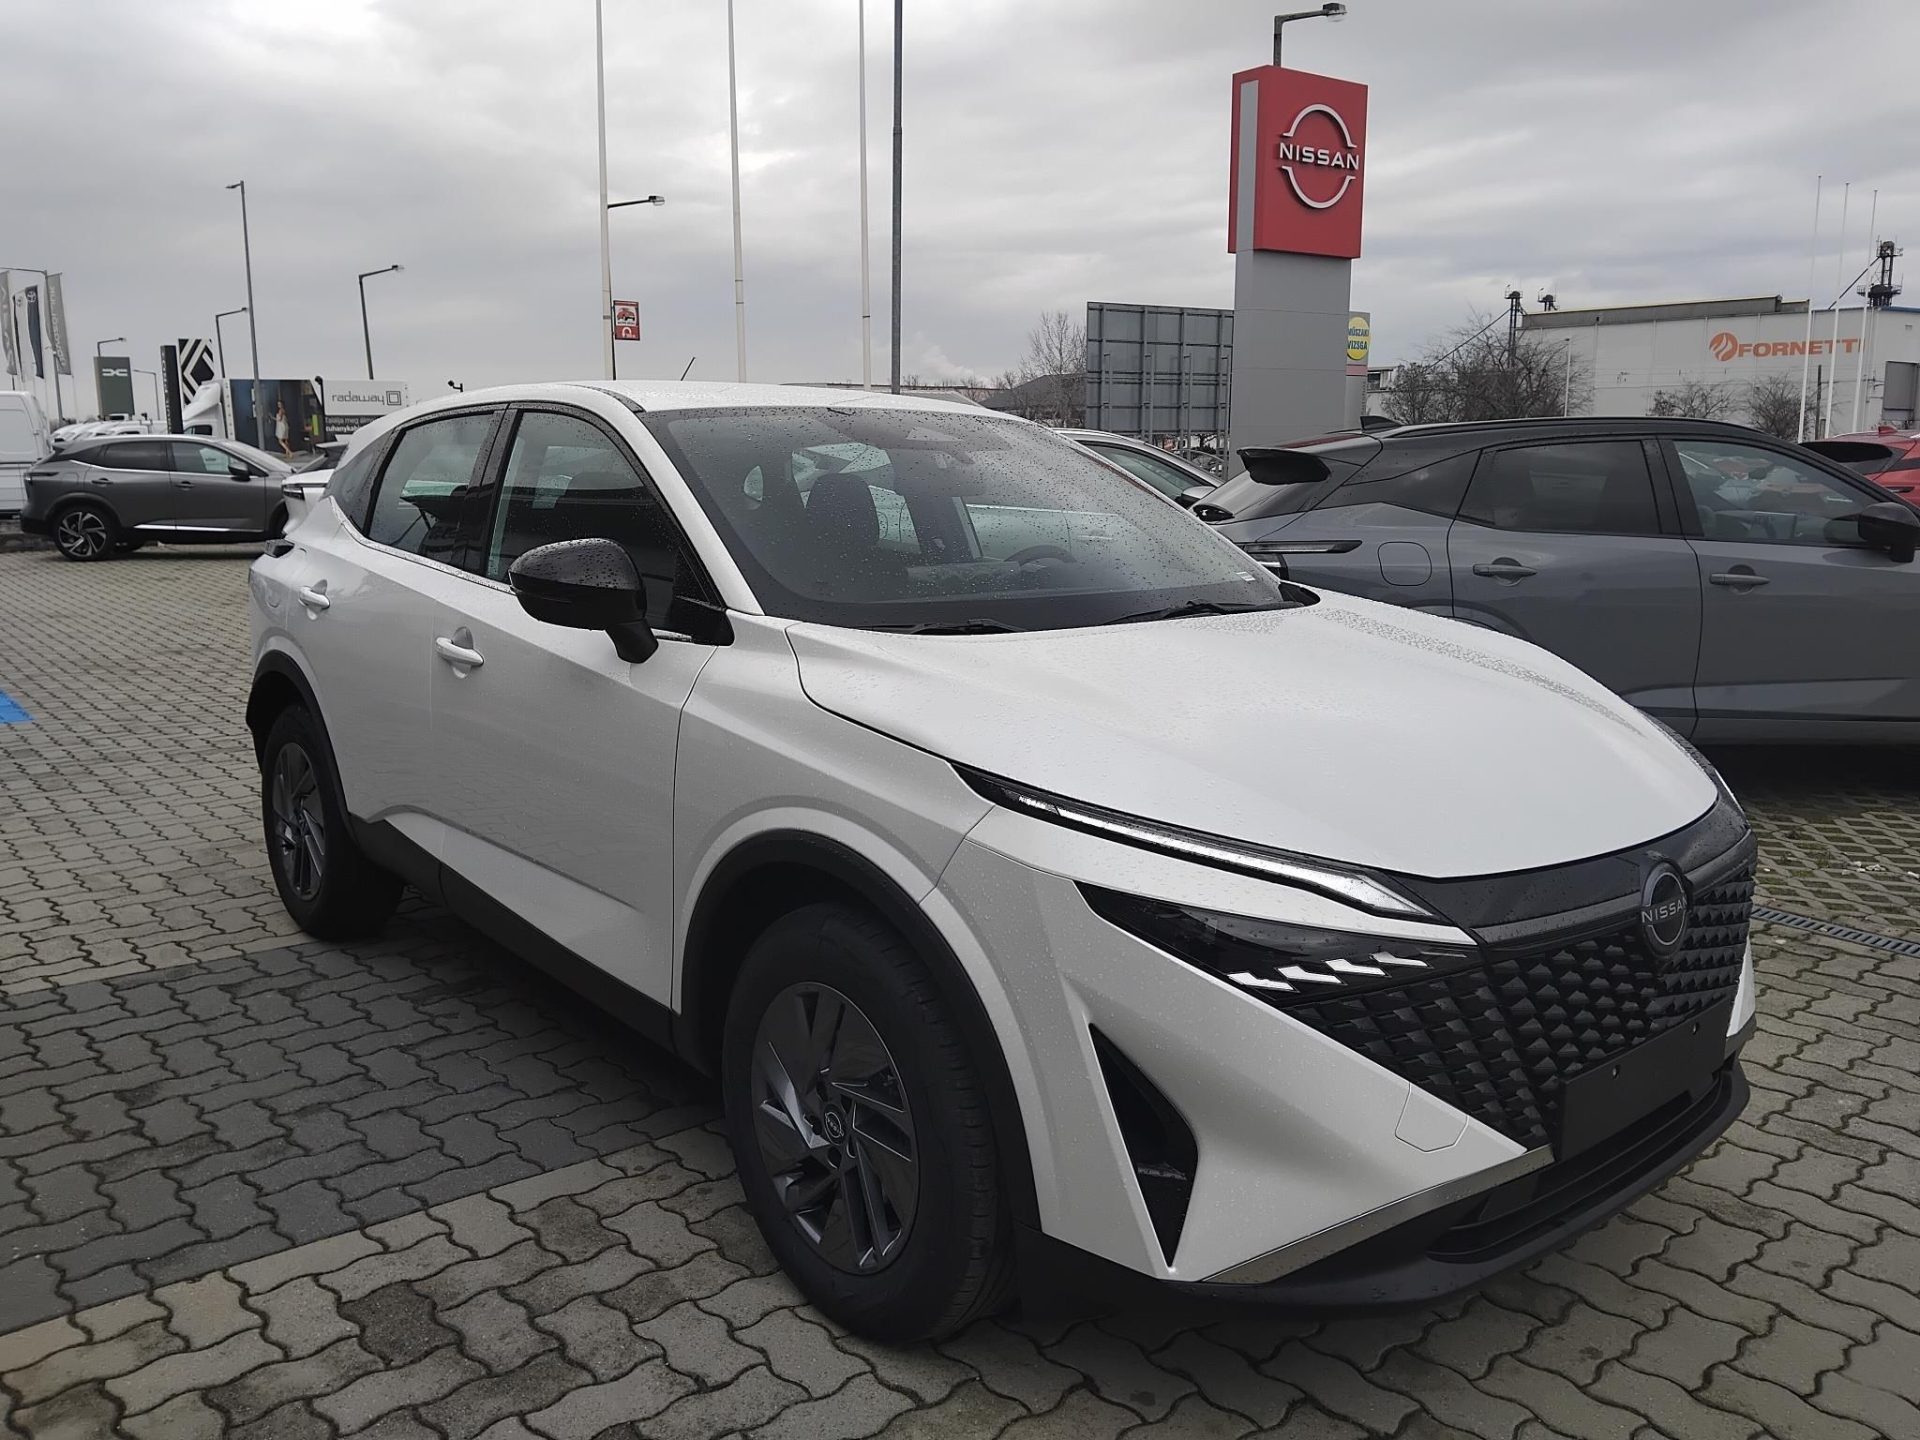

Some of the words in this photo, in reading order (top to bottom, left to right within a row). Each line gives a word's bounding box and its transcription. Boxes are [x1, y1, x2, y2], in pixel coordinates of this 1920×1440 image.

[1280, 142, 1359, 170] NISSAN
[331, 390, 385, 405] radaway
[1641, 897, 1687, 923] NISSAN
